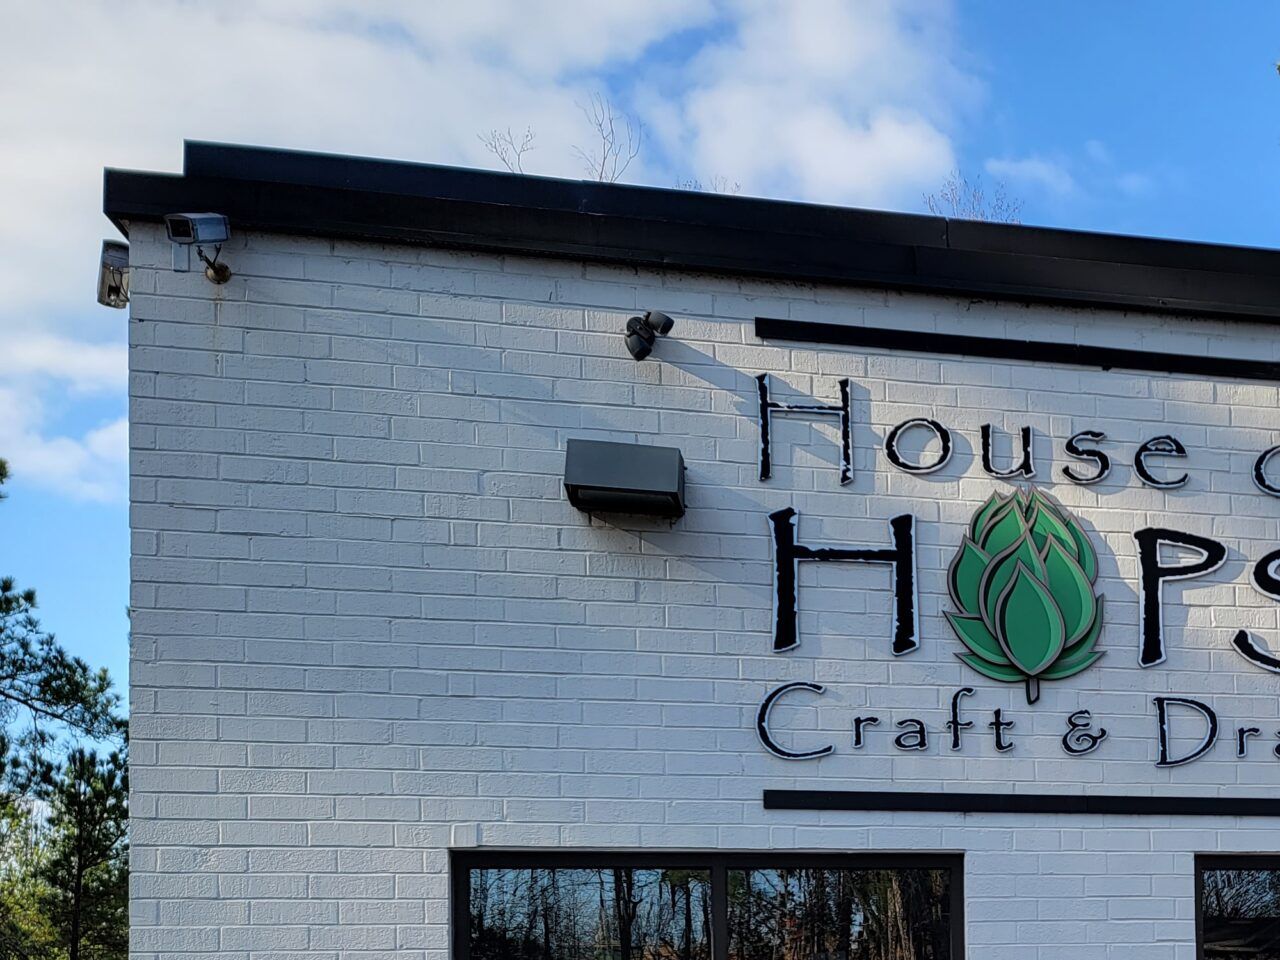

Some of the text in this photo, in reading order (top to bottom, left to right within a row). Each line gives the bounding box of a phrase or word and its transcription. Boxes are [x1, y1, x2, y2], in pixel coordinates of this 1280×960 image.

[754, 372, 1190, 490] House
[757, 681, 1015, 761] Craft
[1061, 708, 1108, 755] &
